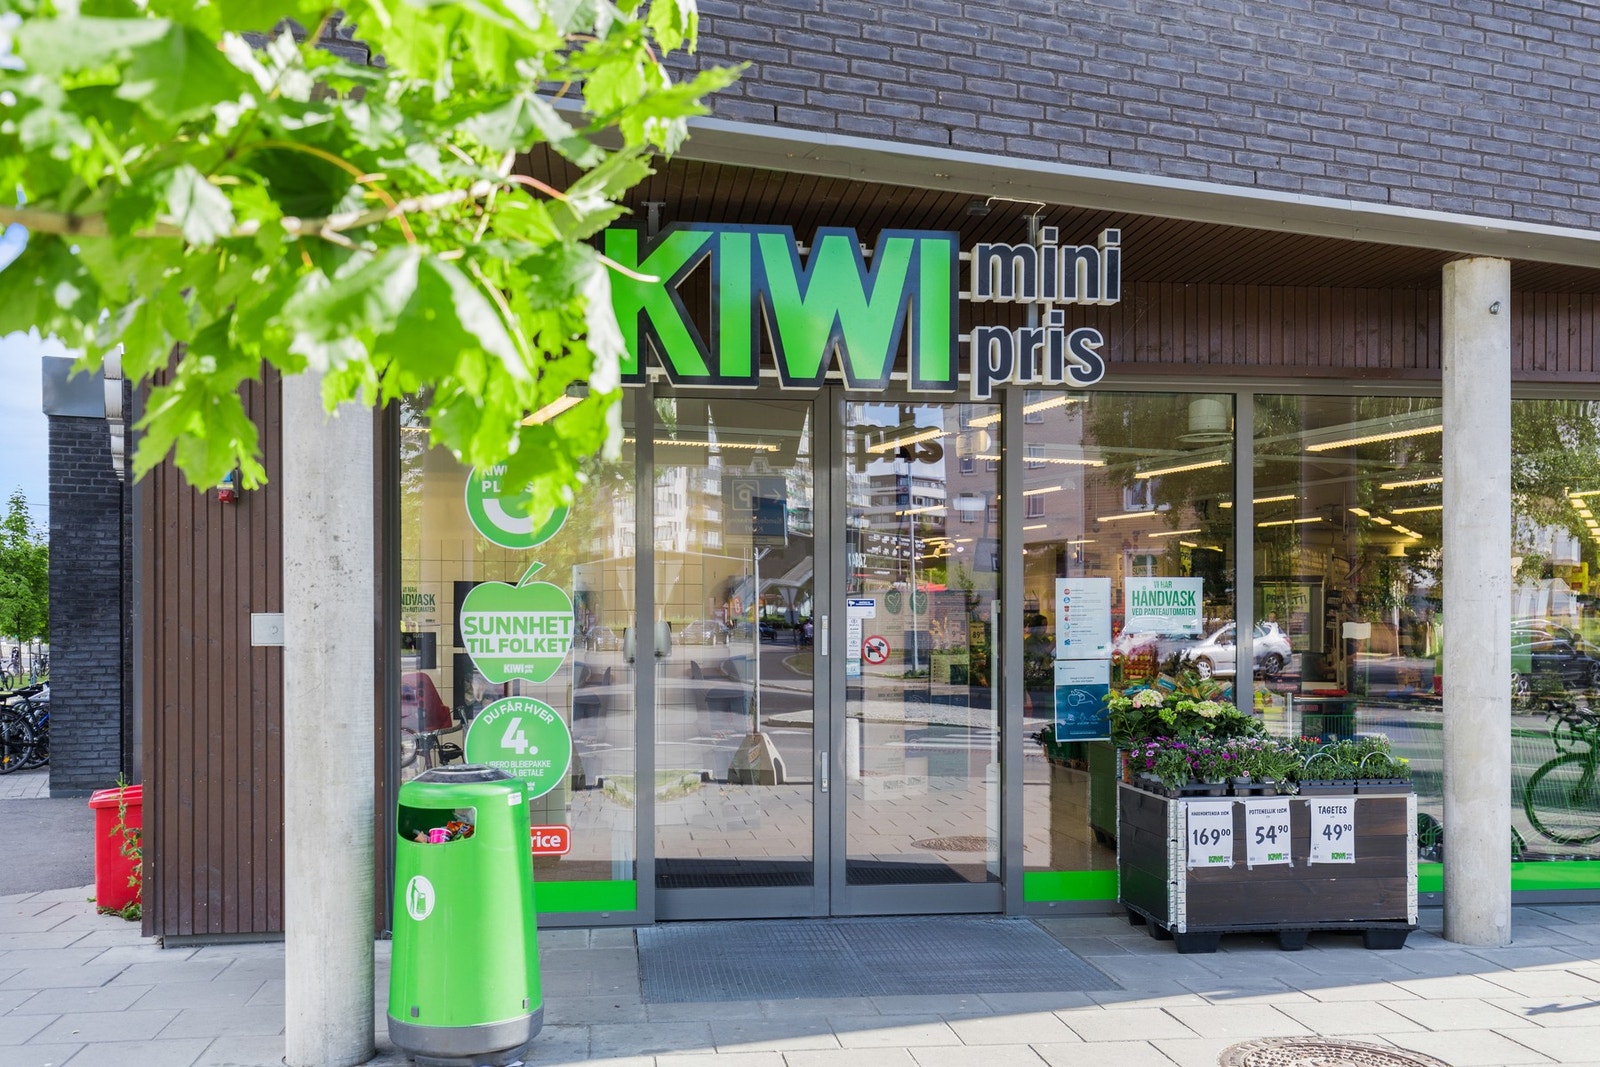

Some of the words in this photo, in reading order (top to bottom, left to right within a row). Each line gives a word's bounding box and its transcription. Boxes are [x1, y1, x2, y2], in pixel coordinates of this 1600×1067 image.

[974, 227, 1121, 304] mini
[602, 223, 960, 389] KIWI
[972, 310, 1105, 398] pris
[482, 481, 534, 493] PLS
[1160, 580, 1173, 589] HAR
[1132, 586, 1196, 606] HÅNDVASK
[1132, 607, 1143, 616] VED
[1144, 607, 1196, 616] PANTEAUTOMATEN
[463, 615, 573, 635] SUNNHET
[467, 638, 495, 653] TIL
[498, 638, 570, 653] FOLKET
[503, 663, 524, 674] KIWI
[482, 708, 501, 725] DU
[500, 700, 523, 716] FÅR
[524, 702, 555, 725] HVER
[501, 716, 539, 756] 4.
[518, 769, 544, 777] BETALE
[1318, 805, 1348, 815] TAGETES
